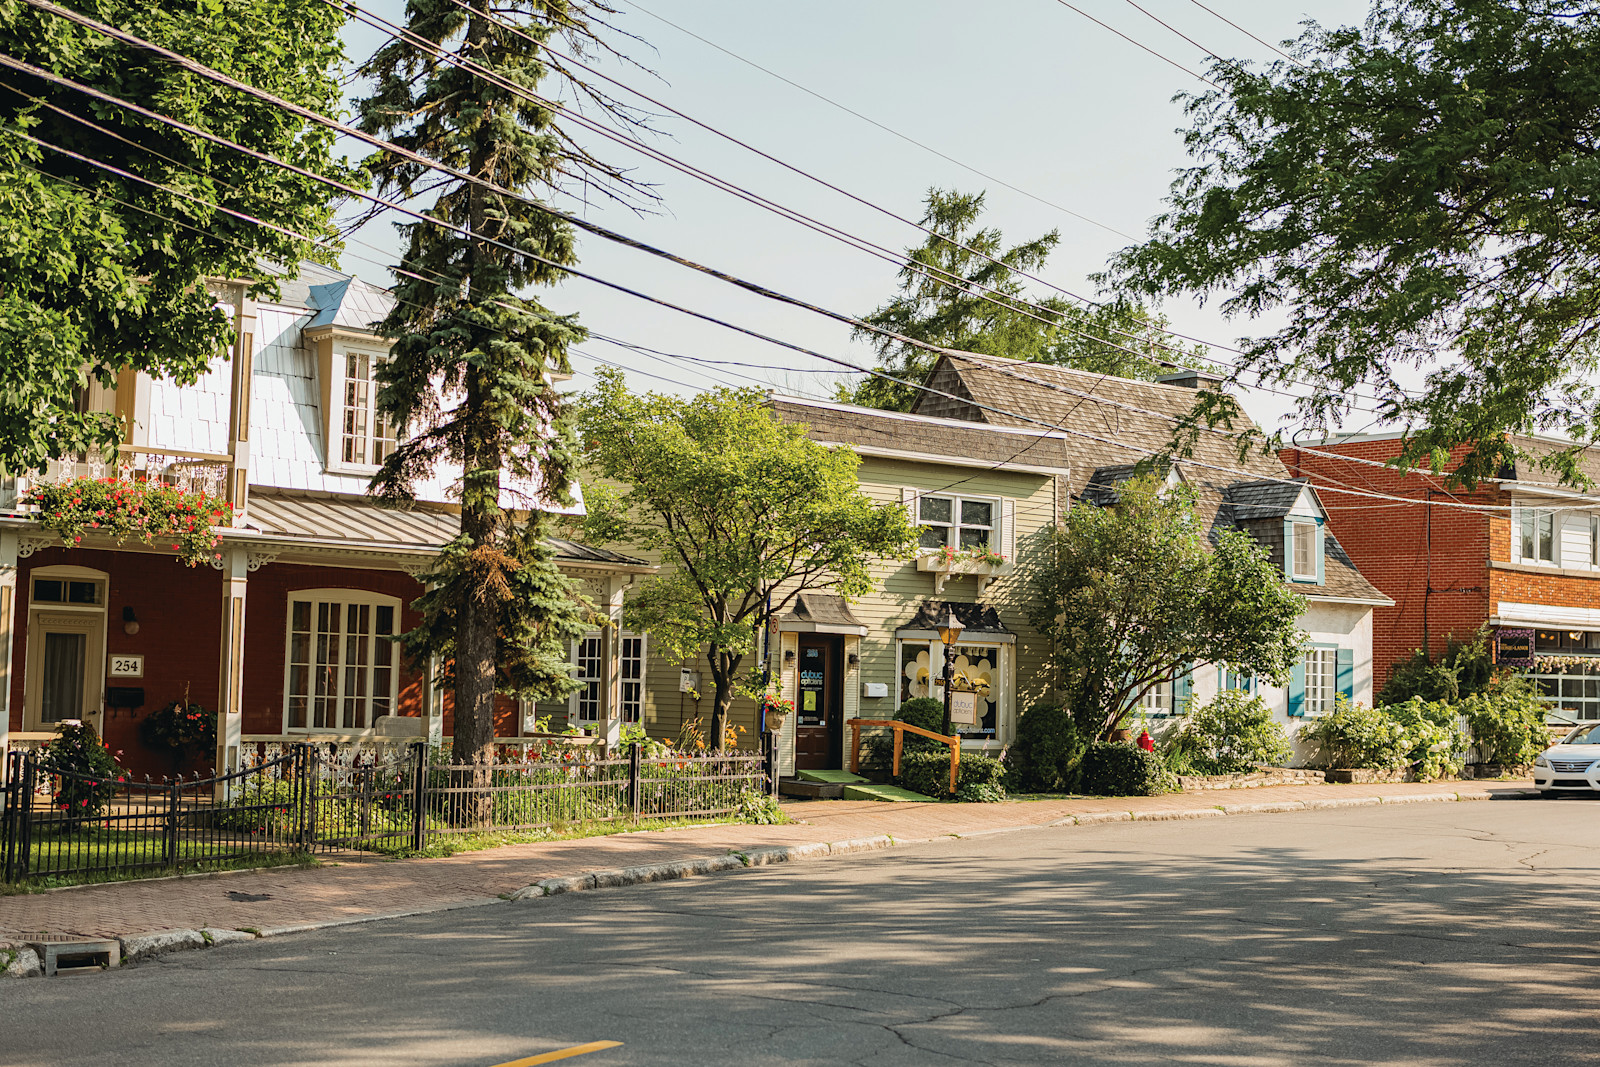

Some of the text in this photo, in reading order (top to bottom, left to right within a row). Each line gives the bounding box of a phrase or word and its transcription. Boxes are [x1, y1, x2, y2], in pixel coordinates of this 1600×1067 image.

[115, 660, 138, 672] 254
[801, 670, 823, 679] dubuc
[953, 700, 972, 708] dubuc
